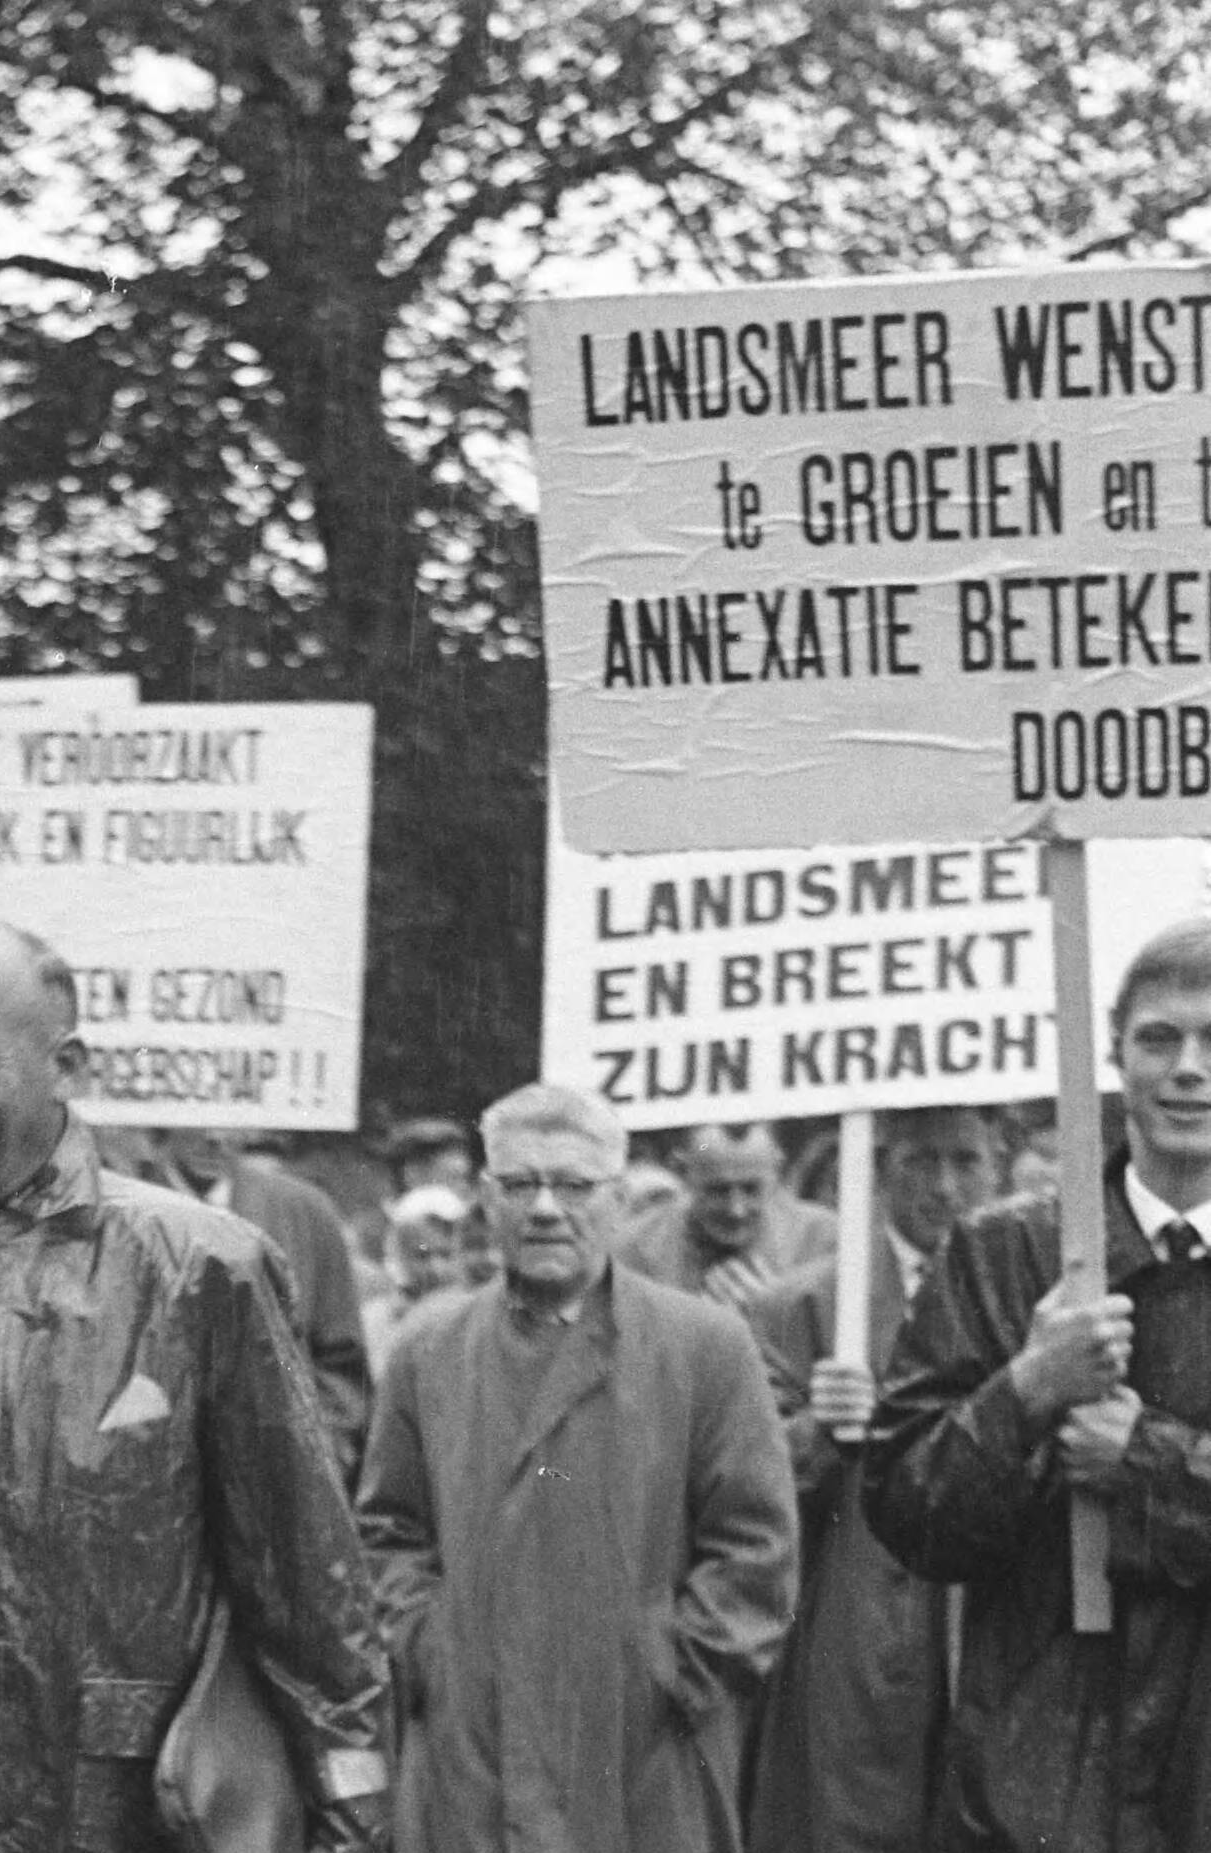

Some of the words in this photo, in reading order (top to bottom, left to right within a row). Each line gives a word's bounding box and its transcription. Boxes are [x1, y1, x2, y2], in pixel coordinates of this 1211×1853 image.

[580, 311, 953, 427] LANDSMEER
[996, 294, 1211, 400] WENST
[716, 460, 762, 551] te
[801, 441, 1064, 547] GROEIEN
[1103, 458, 1157, 533] en
[1195, 436, 1211, 530] t
[603, 583, 921, 688] ANNEXATIE
[957, 570, 1211, 673] BETEKE
[1012, 706, 1211, 802] DOODB
[42, 808, 83, 866] EN
[595, 844, 1048, 942] LANDSMEE
[149, 968, 285, 1025] GEZOND
[593, 960, 689, 1024] EN
[720, 929, 1034, 1011] BREEKT
[85, 1045, 278, 1103] RGERSCHAP
[592, 1036, 751, 1104] ZIJN
[781, 1011, 1056, 1089] KRACH
